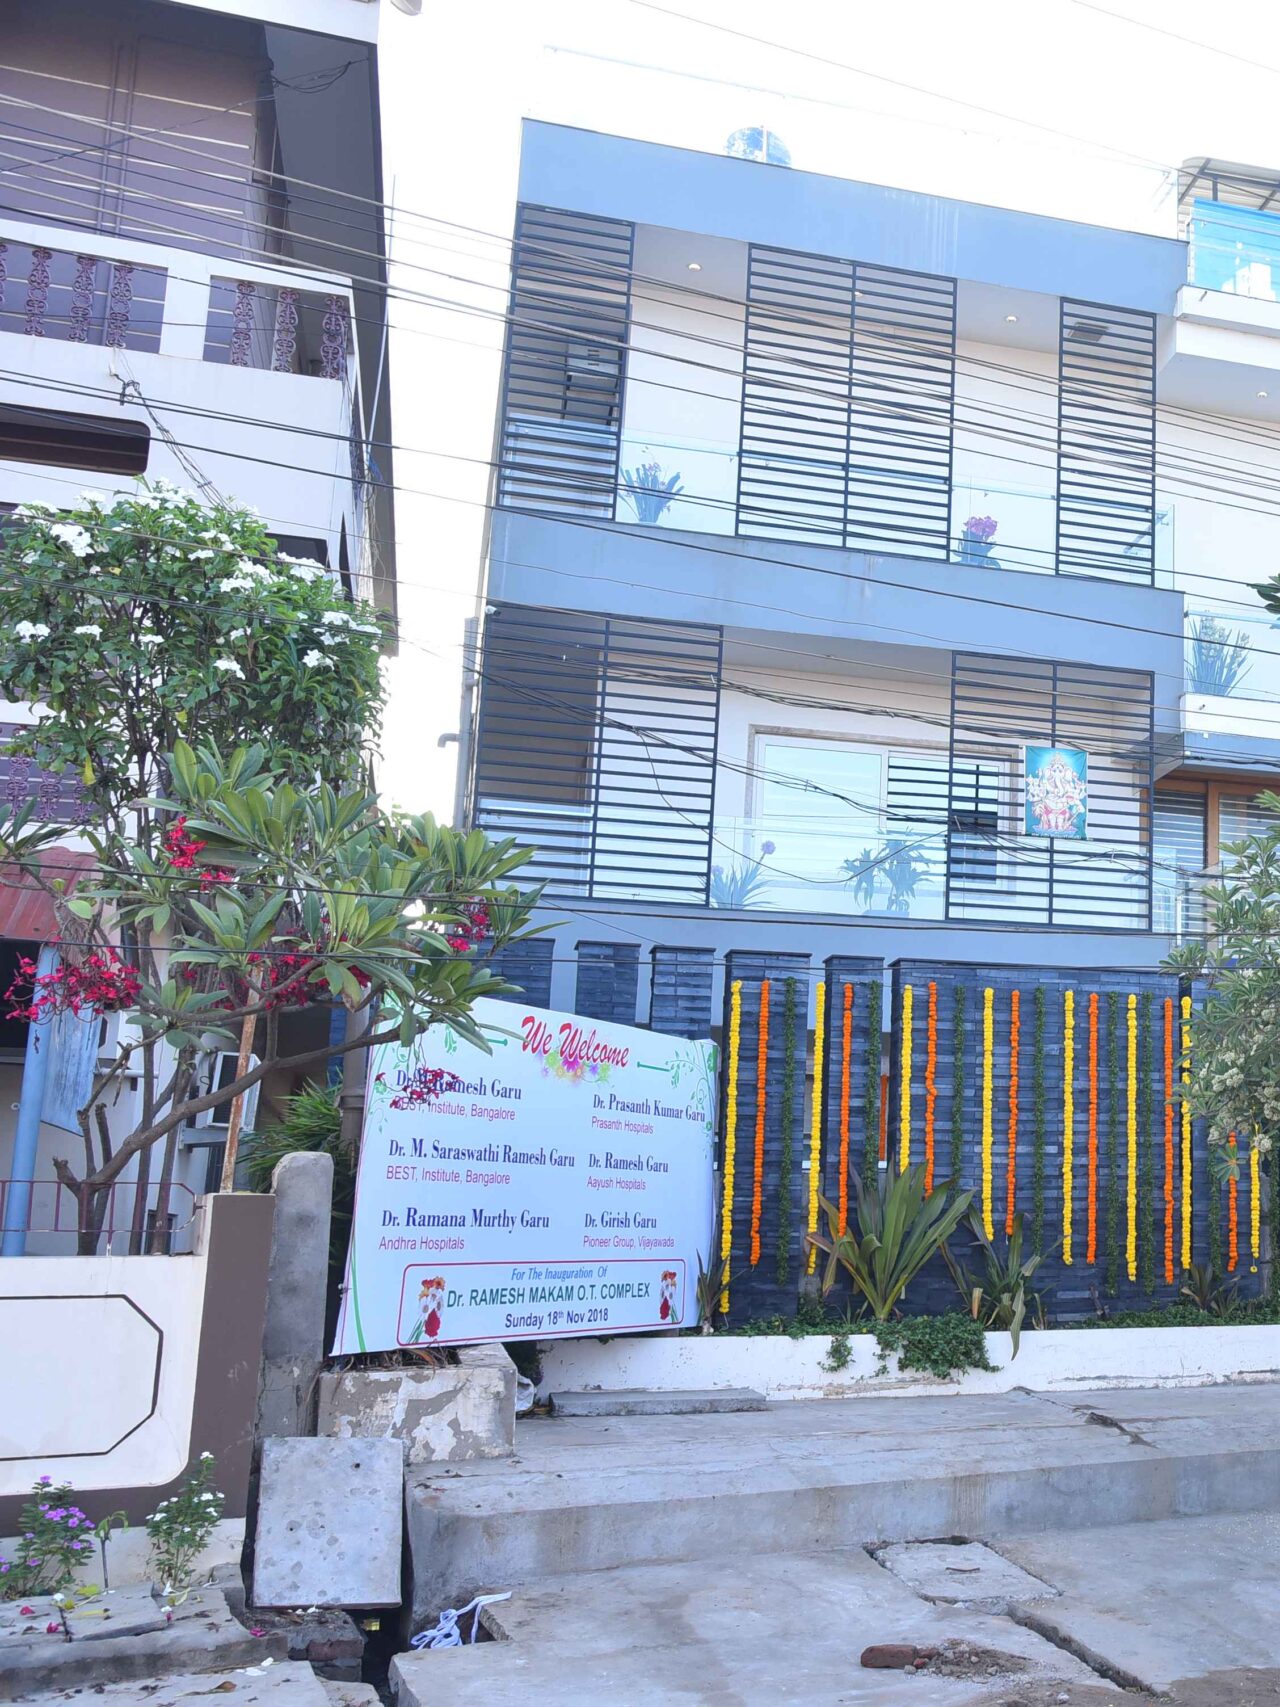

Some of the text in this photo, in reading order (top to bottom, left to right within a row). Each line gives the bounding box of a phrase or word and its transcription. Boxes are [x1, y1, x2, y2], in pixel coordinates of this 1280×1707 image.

[521, 1015, 629, 1067] We Welcome
[491, 1078, 522, 1100] Garu
[471, 1103, 516, 1121] Bangalore
[593, 1093, 706, 1122] Dr. Prasanth Kumar Garu
[591, 1115, 654, 1134] Prasanth Hospitals
[388, 1137, 575, 1167] Dr. M. Saraswathi Ramesh Garu
[588, 1151, 669, 1173] Dr. Ramesh Garu
[386, 1165, 510, 1187] BEST, Institute, Bangalore
[587, 1175, 646, 1192] Aayush Hospitals
[381, 1206, 549, 1234] Dr. Ramana Murthy Garu
[584, 1210, 657, 1228] Dr. Girish Garu
[378, 1236, 465, 1252] Andhra Hospitals
[582, 1235, 611, 1248] Pioneer
[638, 1235, 675, 1250] Vijayawada
[511, 1265, 608, 1282] For The Inauguration Of
[446, 1282, 651, 1308] Dr. RAMESH MAKAM O.T. COMPLEX
[505, 1308, 609, 1330] Sunday 18th Nov 2018
